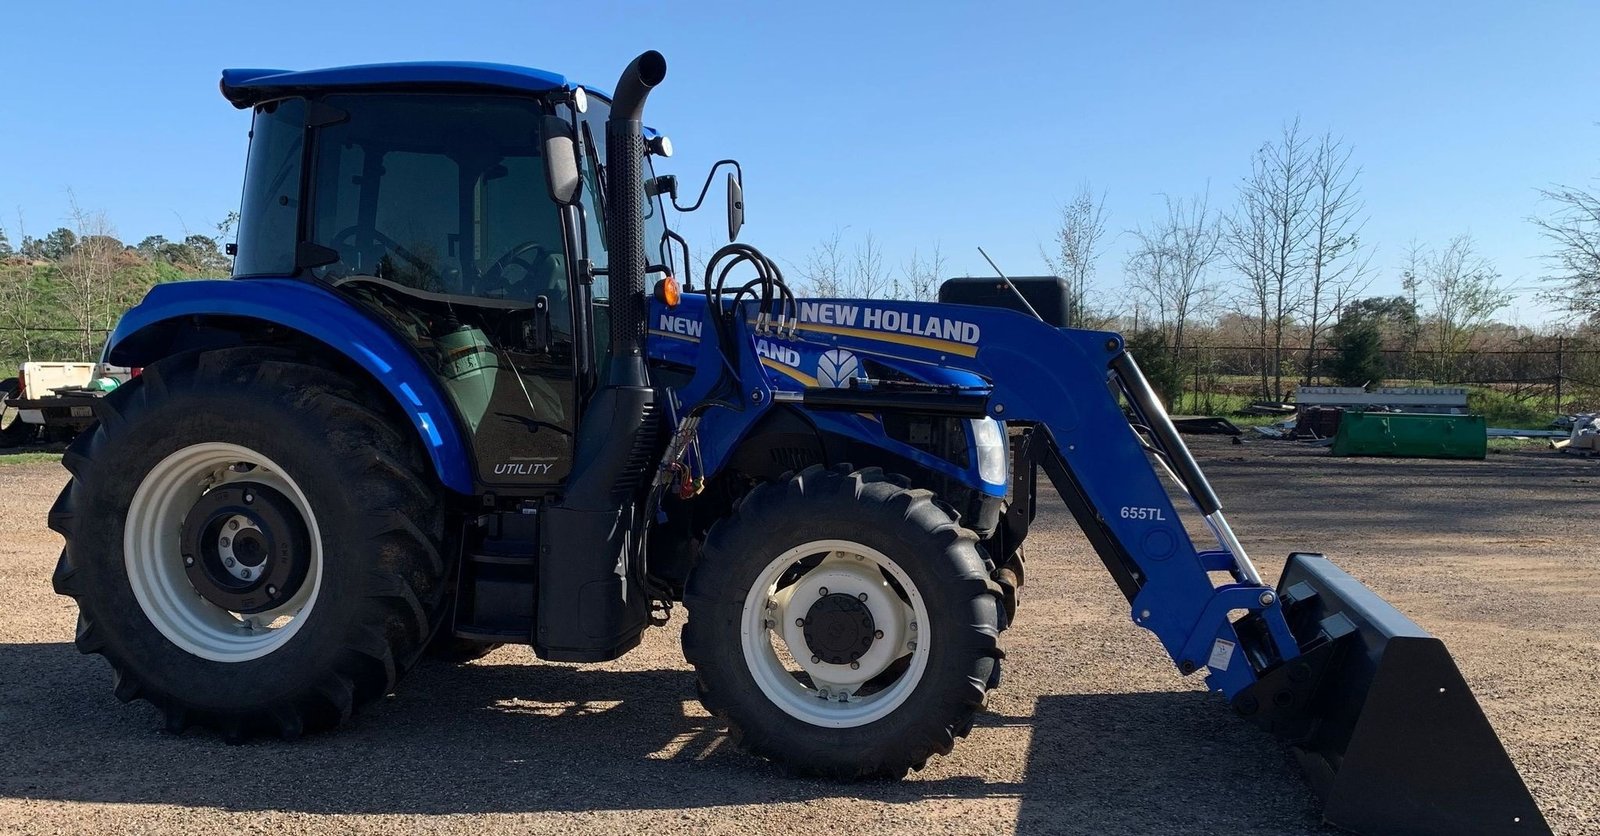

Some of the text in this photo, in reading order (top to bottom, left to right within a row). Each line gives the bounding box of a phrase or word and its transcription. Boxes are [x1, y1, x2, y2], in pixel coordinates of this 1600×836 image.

[660, 314, 702, 338] NEW
[801, 302, 981, 344] NEW HOLLAND
[494, 463, 554, 475] UTILITY
[1120, 506, 1166, 521] 655TL
